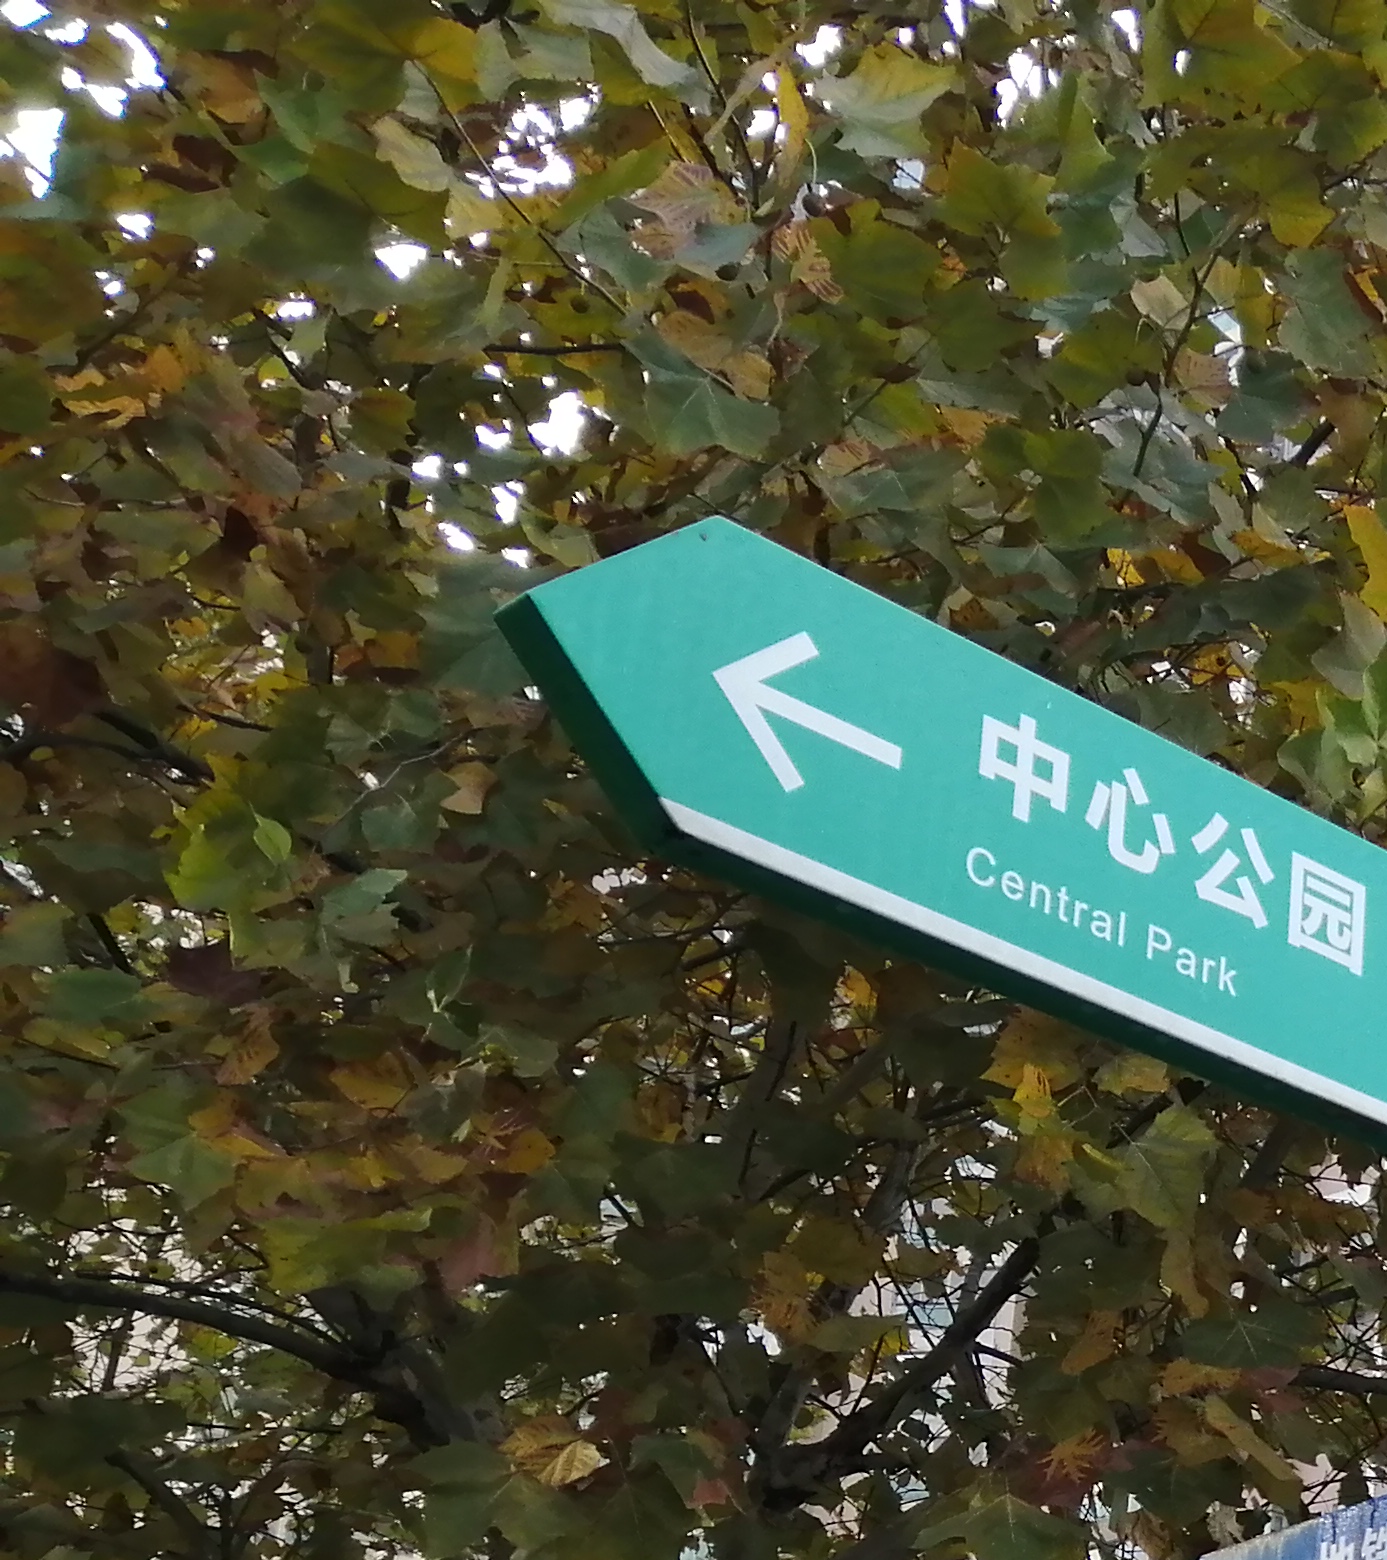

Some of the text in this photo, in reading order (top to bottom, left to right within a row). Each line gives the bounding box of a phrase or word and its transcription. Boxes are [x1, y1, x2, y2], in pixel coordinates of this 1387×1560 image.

[965, 846, 1238, 997] Central Park
[978, 713, 1367, 975] 中心公园
